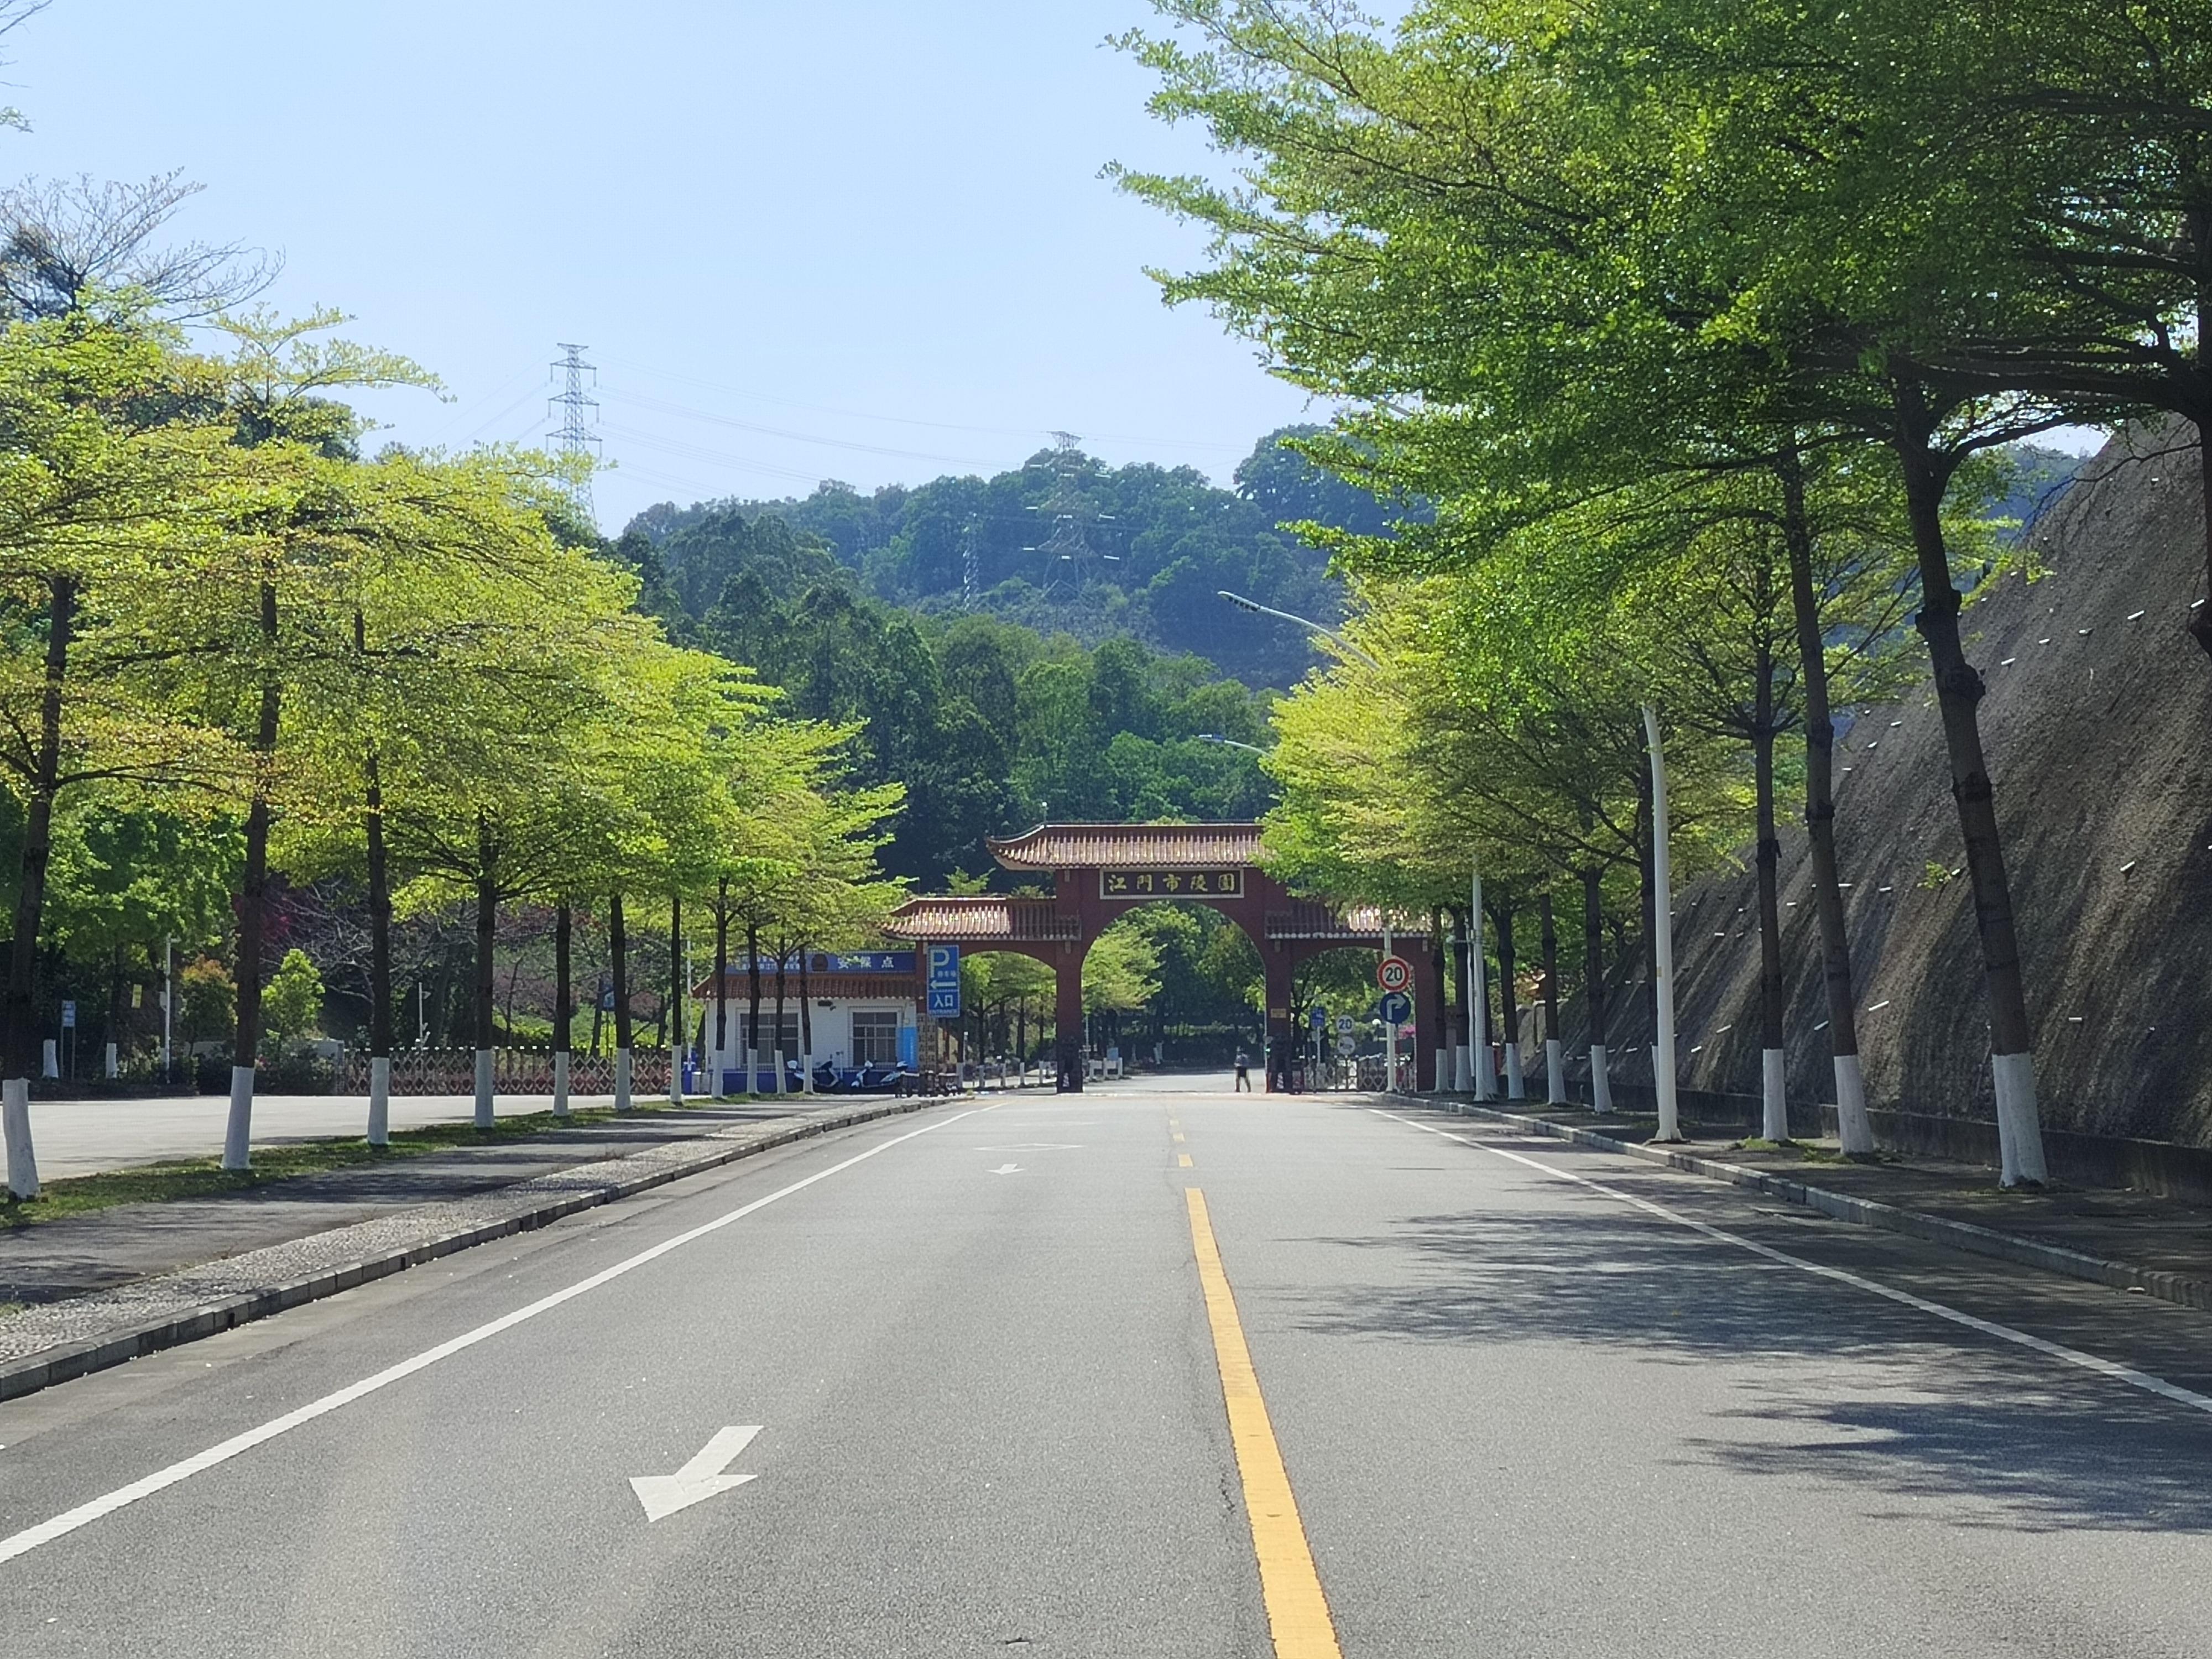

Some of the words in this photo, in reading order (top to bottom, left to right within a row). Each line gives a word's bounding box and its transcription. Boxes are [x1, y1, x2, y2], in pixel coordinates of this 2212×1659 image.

[1108, 873, 1235, 892] 江門市陵園
[930, 949, 950, 978] P
[1385, 967, 1403, 982] 20
[933, 994, 953, 1008] 入口
[1339, 1019, 1353, 1030] 20
